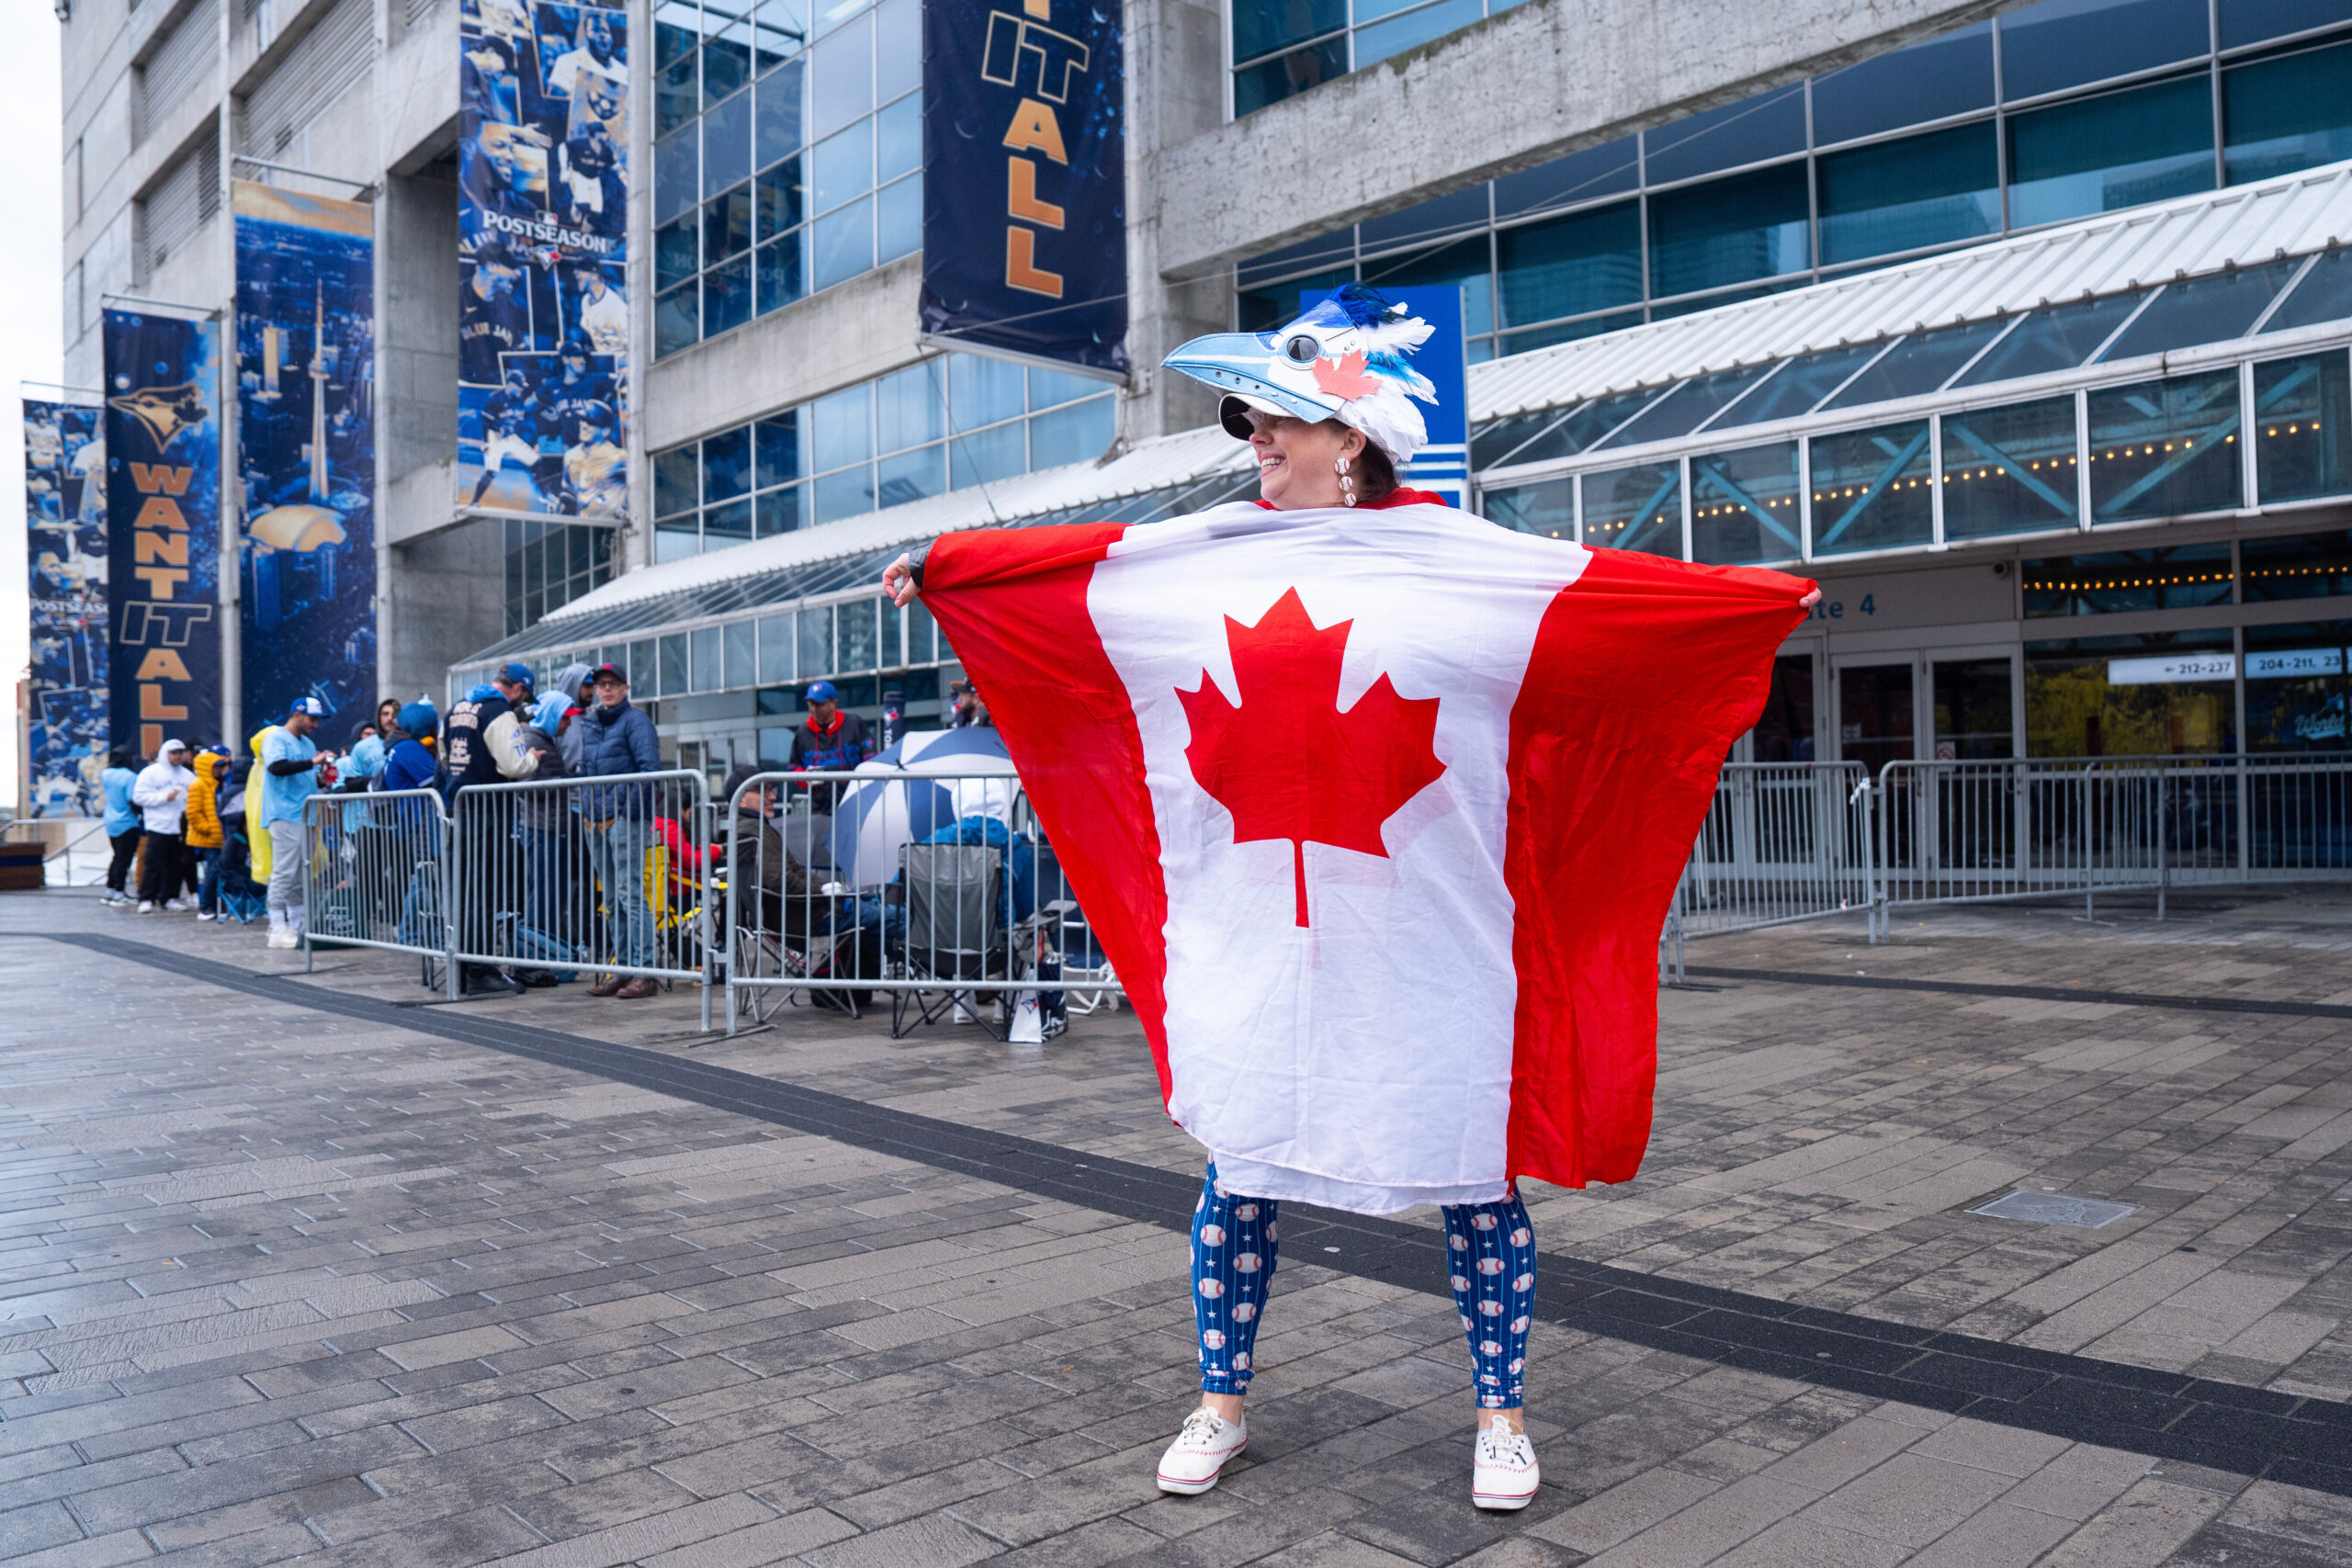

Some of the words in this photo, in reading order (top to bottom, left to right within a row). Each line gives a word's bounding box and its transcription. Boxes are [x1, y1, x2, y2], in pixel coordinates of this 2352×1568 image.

[980, 10, 1091, 105] IT
[1002, 97, 1069, 299] ALL
[482, 209, 607, 254] POSTSEASON
[130, 462, 193, 600] WANT
[29, 598, 109, 615] POSTSEASO
[119, 601, 212, 646] IT
[1805, 597, 1844, 620] te
[1860, 592, 1876, 616] 4
[2178, 660, 2232, 674] 212-237
